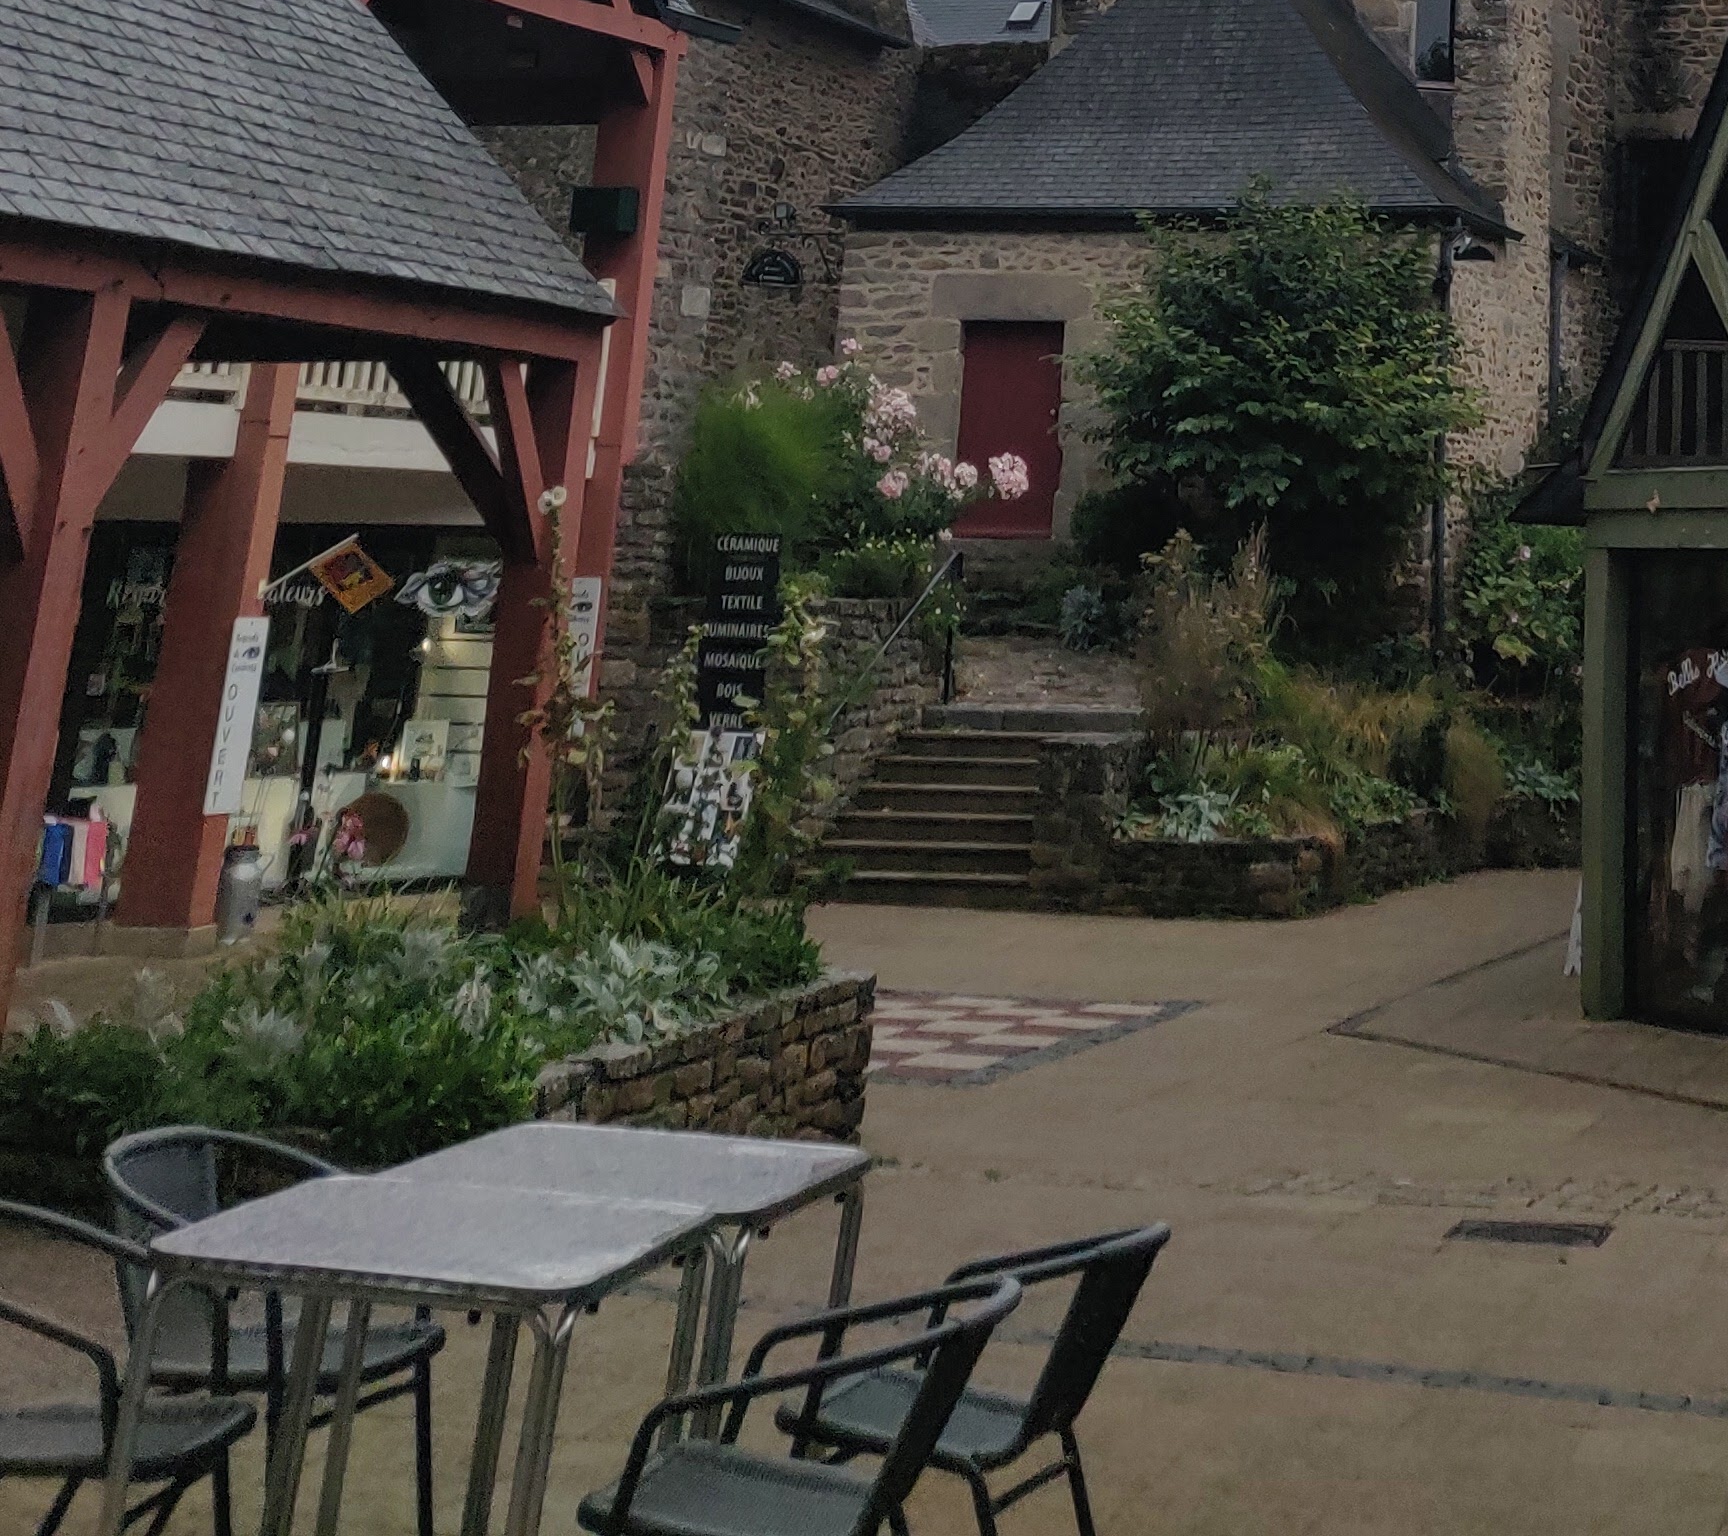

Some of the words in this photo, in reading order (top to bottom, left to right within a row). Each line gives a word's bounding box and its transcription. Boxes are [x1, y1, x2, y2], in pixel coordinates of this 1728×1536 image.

[717, 534, 780, 552] CÉRAMIQUE
[725, 565, 764, 581] BIJOUX
[721, 595, 763, 610] TEXTILE
